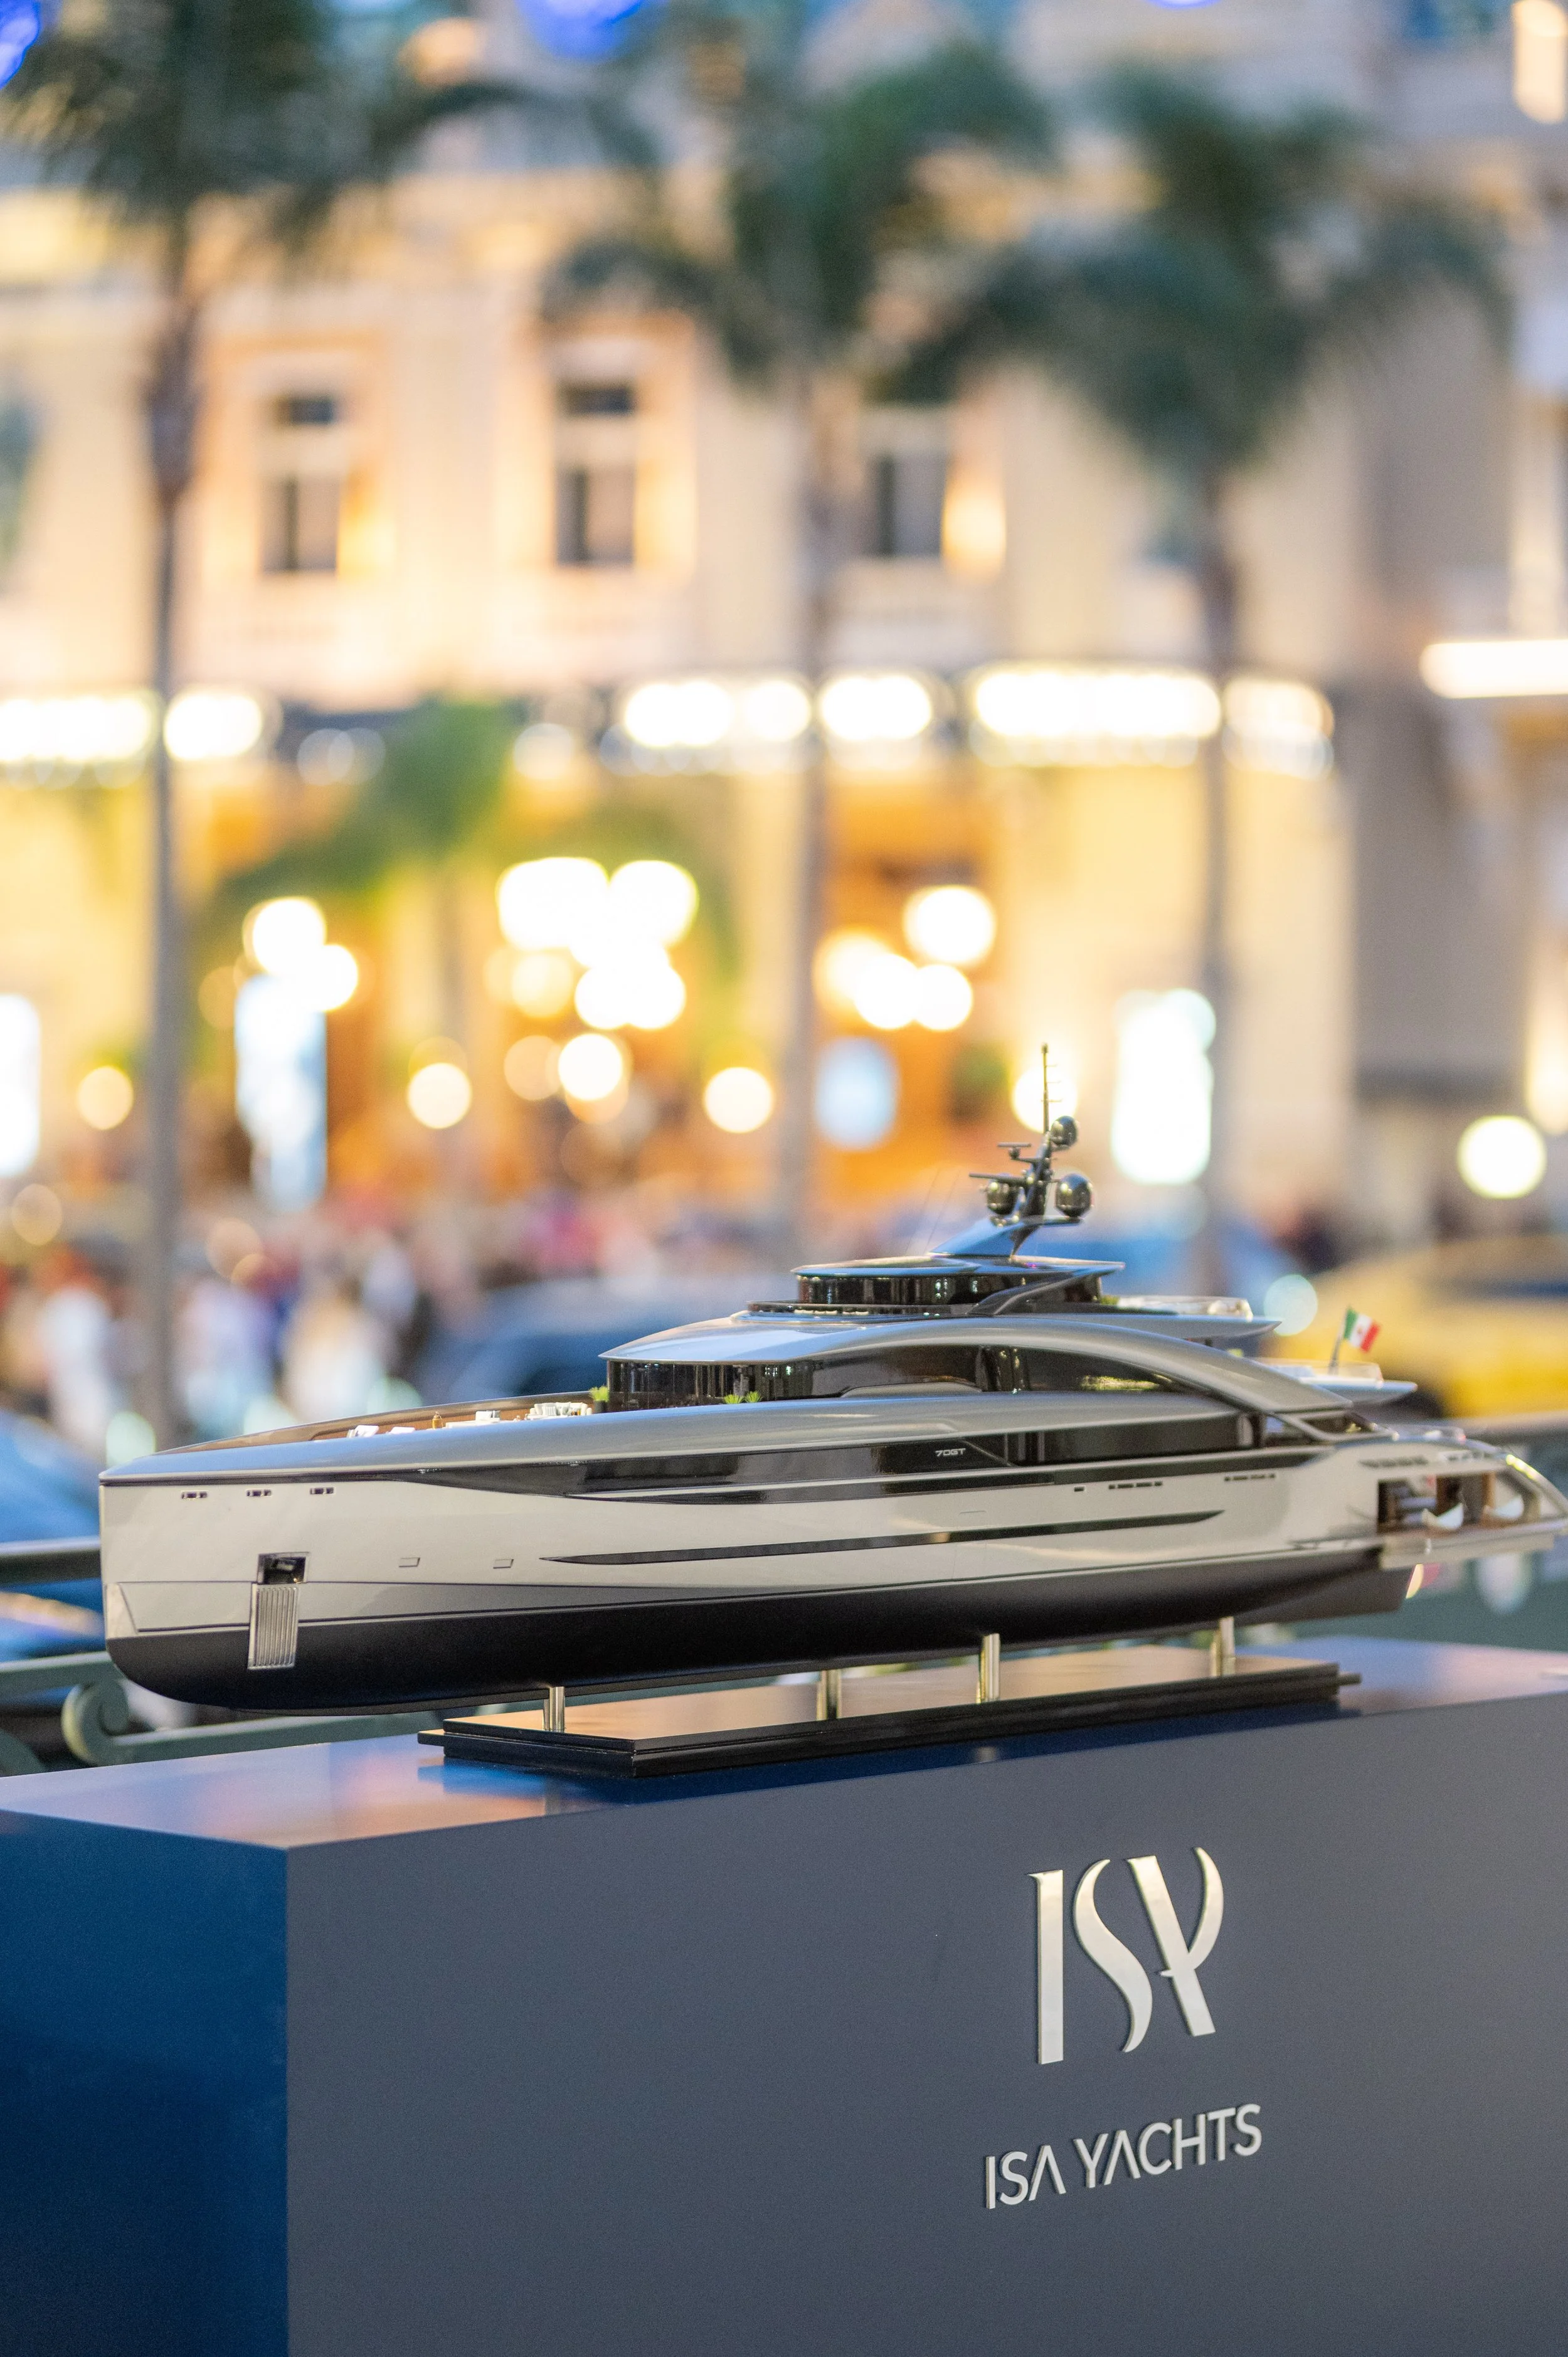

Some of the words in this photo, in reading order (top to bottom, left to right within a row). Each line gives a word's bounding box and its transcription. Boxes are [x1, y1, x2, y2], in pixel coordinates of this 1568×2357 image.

[935, 1447, 967, 1457] 70GT
[985, 2144, 1067, 2210] ISA
[1073, 2103, 1263, 2189] YACHTS
